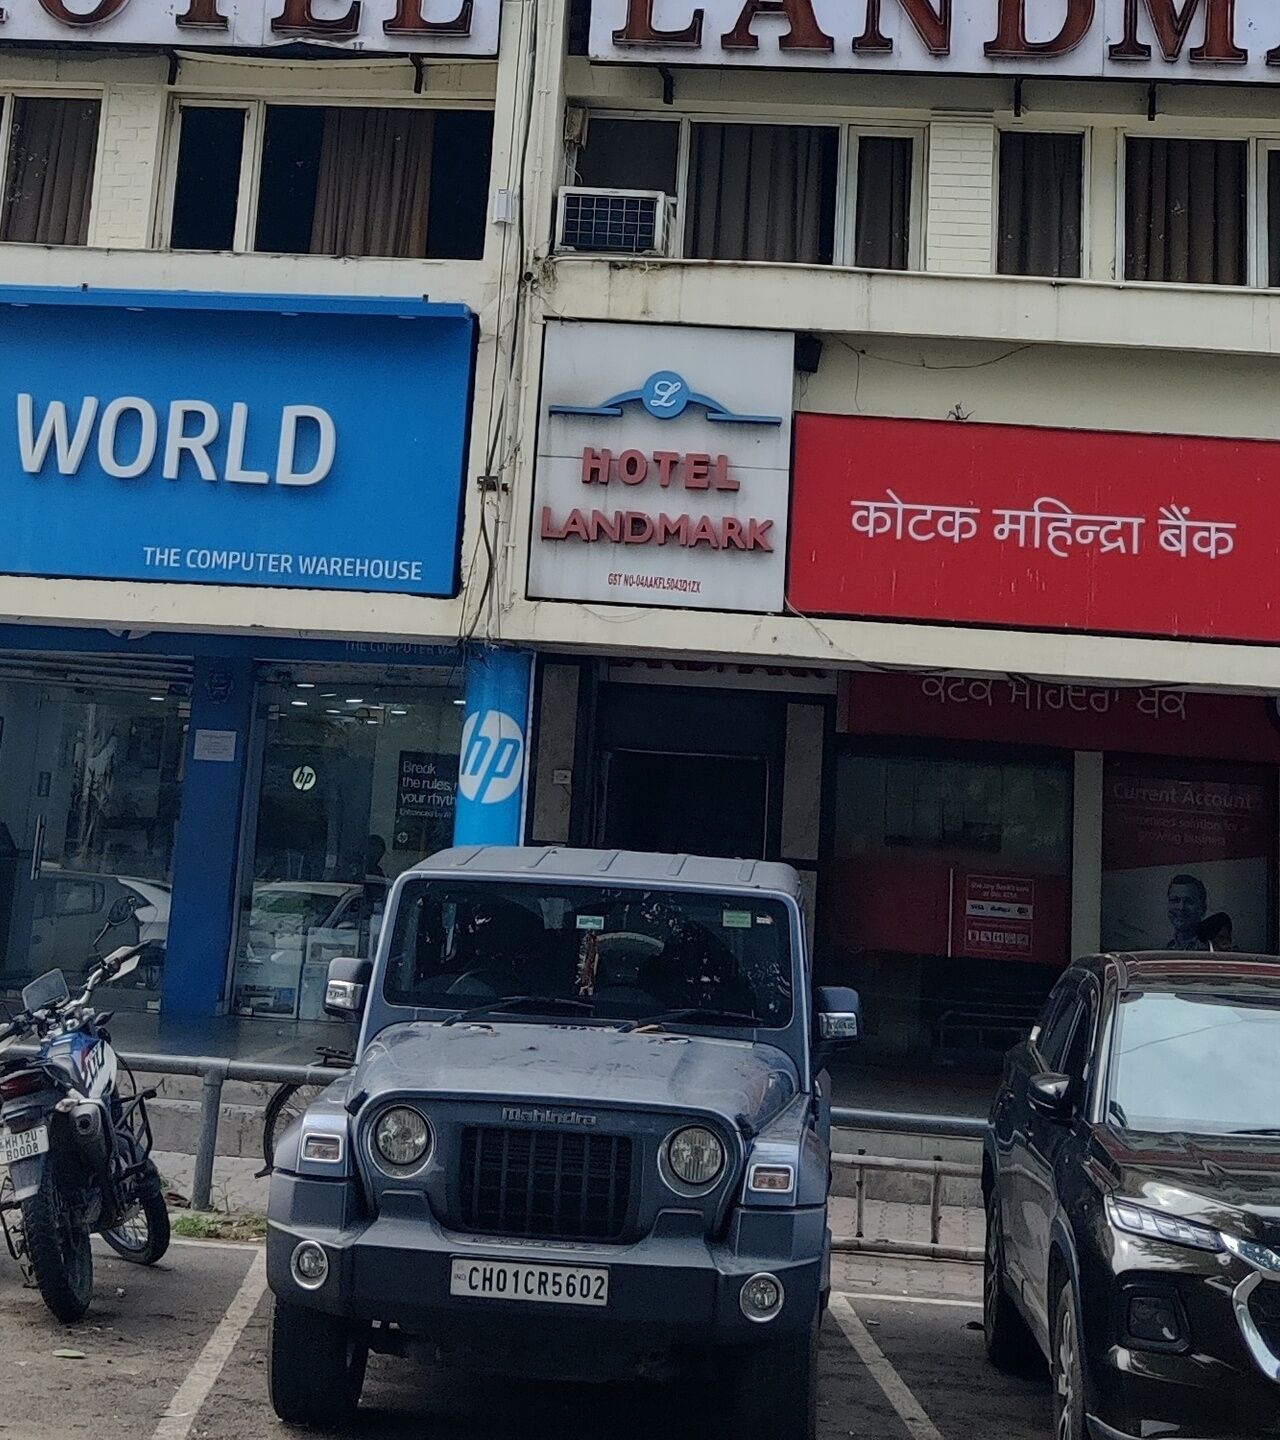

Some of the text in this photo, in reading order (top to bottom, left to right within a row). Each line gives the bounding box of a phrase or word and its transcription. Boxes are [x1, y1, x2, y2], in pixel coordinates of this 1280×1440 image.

[17, 392, 337, 488] WORLD
[581, 446, 741, 492] HOTEL
[540, 506, 775, 553] LANDMARK
[850, 487, 1237, 559] कोटक महिन्द्रा बैंक
[143, 545, 423, 581] THE COMPUTER WAREHOUSE
[607, 572, 623, 586] GST
[403, 760, 437, 775] Break
[458, 709, 524, 805] hp
[292, 765, 317, 791] hp
[402, 776, 421, 789] the
[422, 778, 453, 792] rules,
[400, 793, 427, 806] your
[1113, 782, 1255, 810] Current Account
[469, 1266, 606, 1300] CH01CR5602
